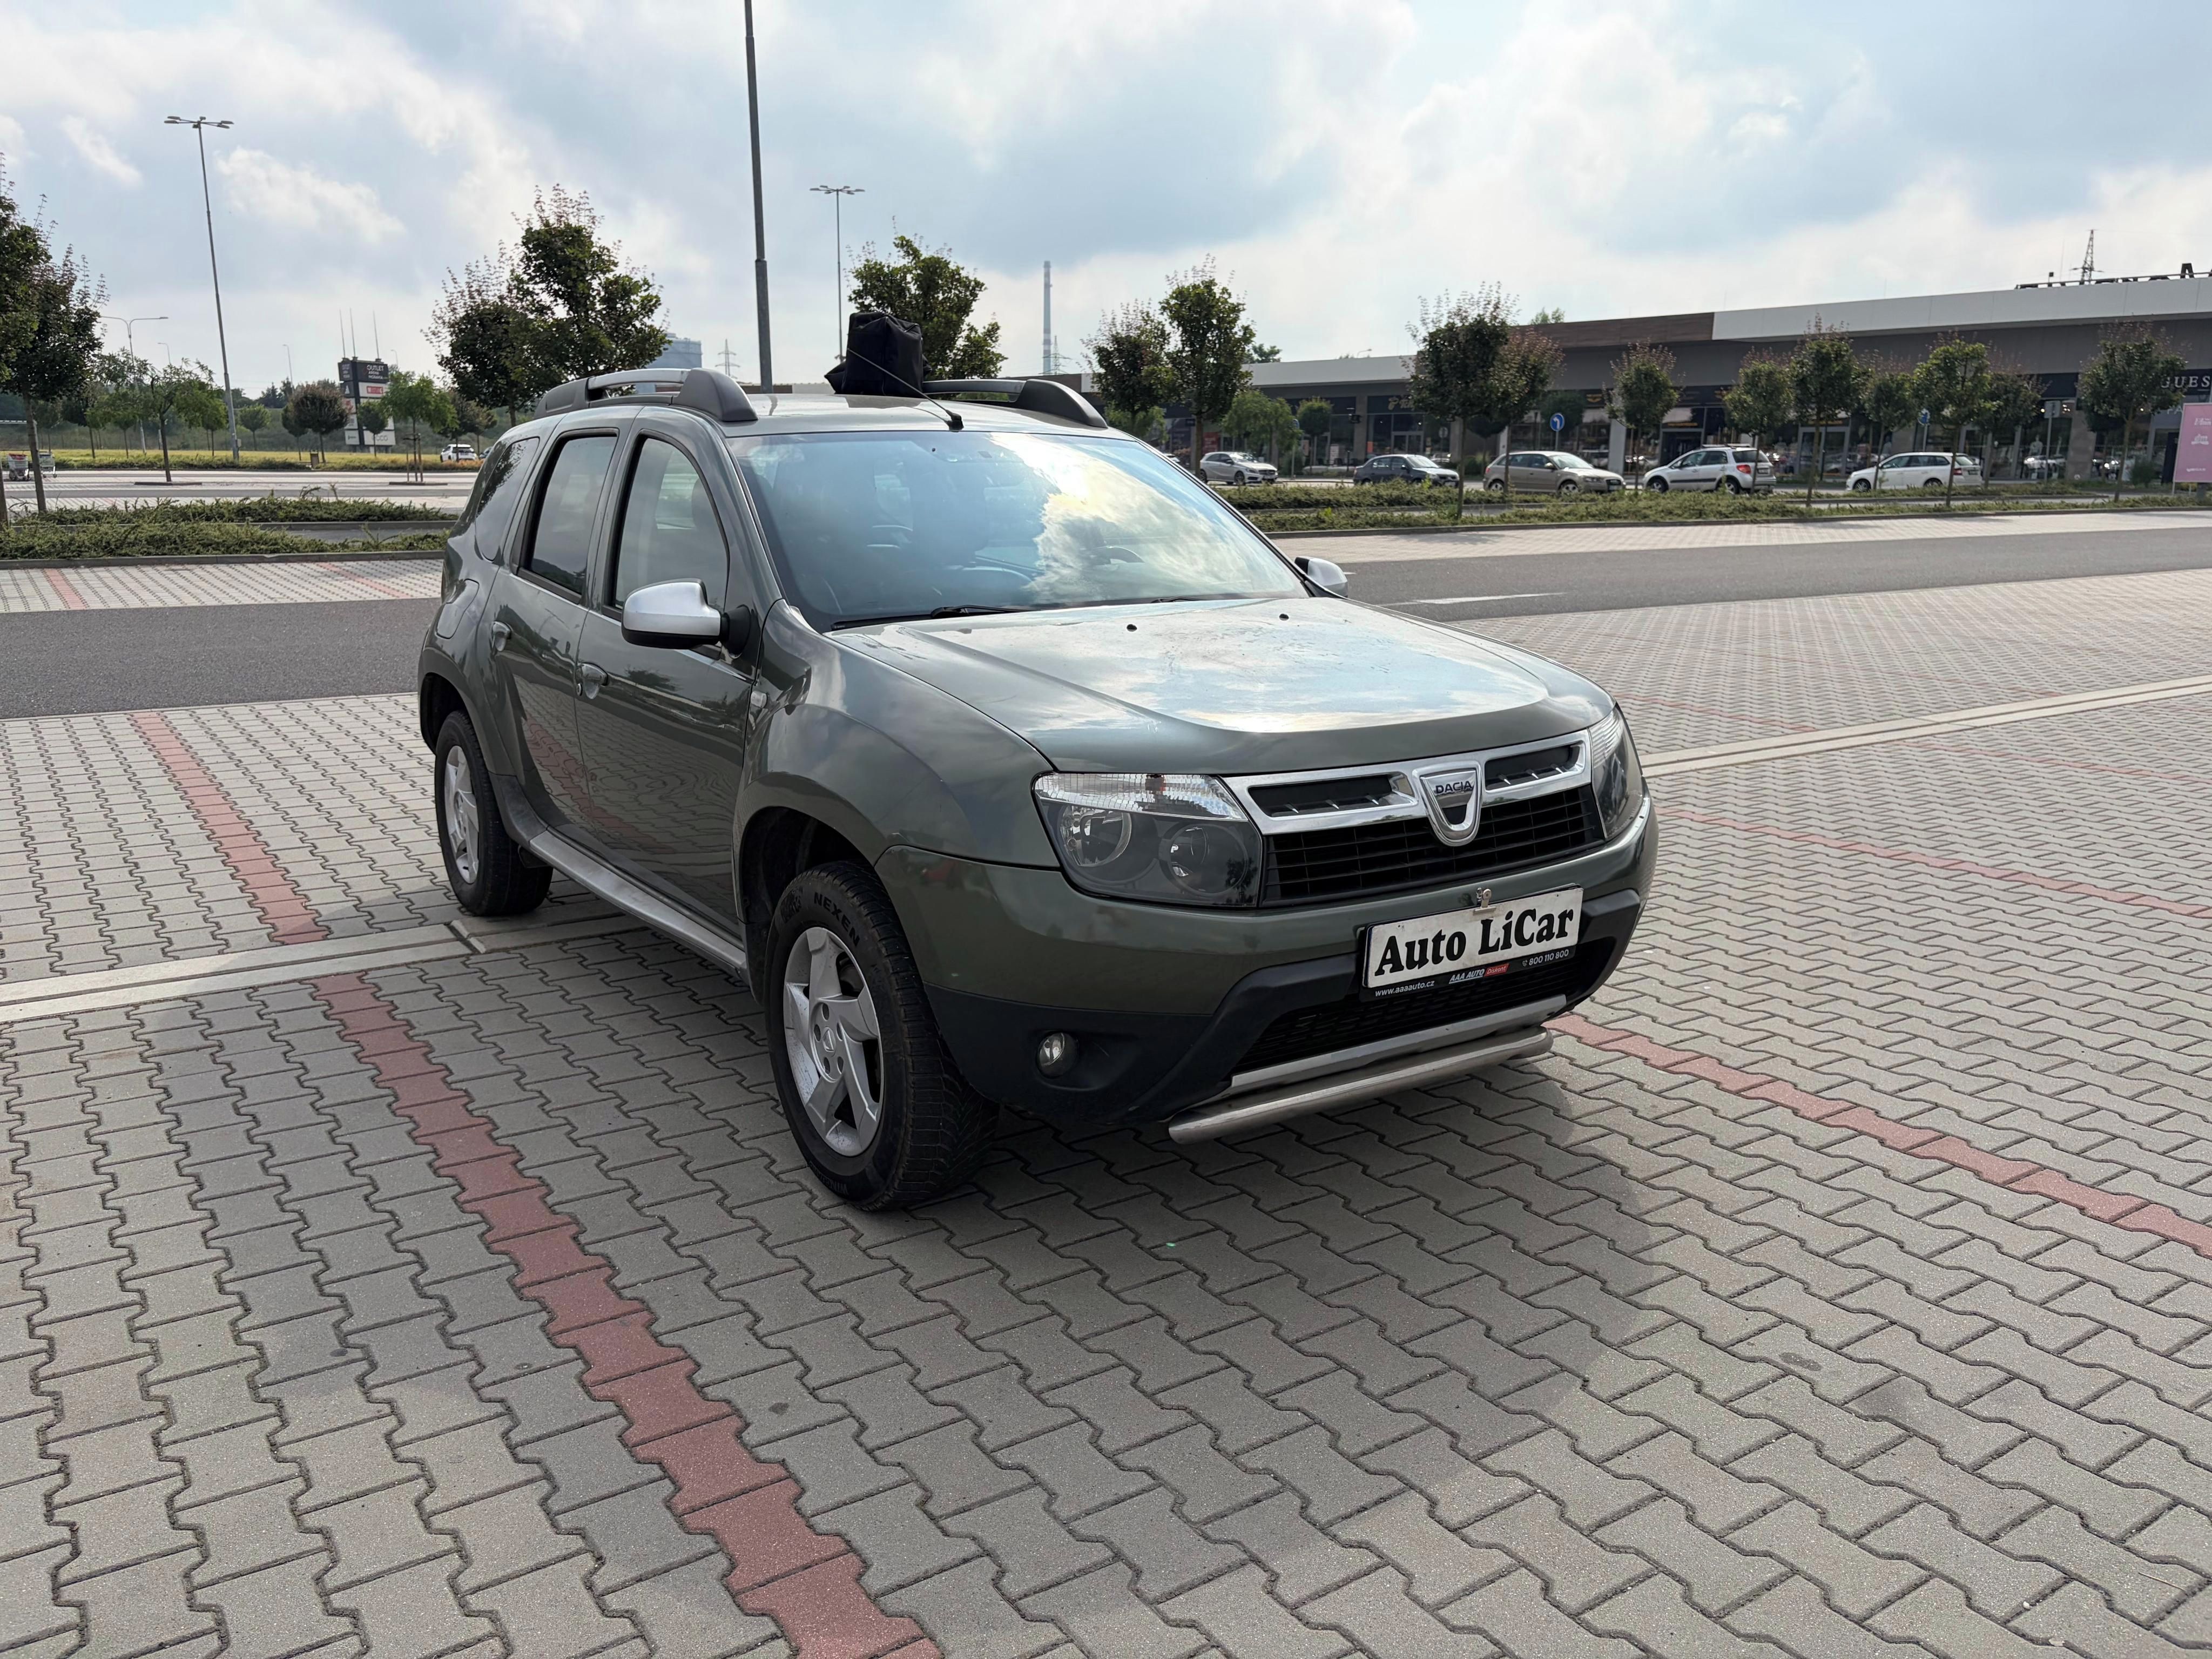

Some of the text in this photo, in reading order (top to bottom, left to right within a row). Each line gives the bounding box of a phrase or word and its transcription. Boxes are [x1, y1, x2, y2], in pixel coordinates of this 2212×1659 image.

[1435, 781, 1473, 794] DACIA
[814, 892, 860, 946] NEXEN
[1374, 908, 1574, 976] Auto LiCar
[1529, 957, 1543, 966] 800
[1555, 949, 1569, 959] 800
[1449, 966, 1506, 982] AAA AUTO Diskont
[1375, 981, 1434, 997] www.aaaauto.cz
